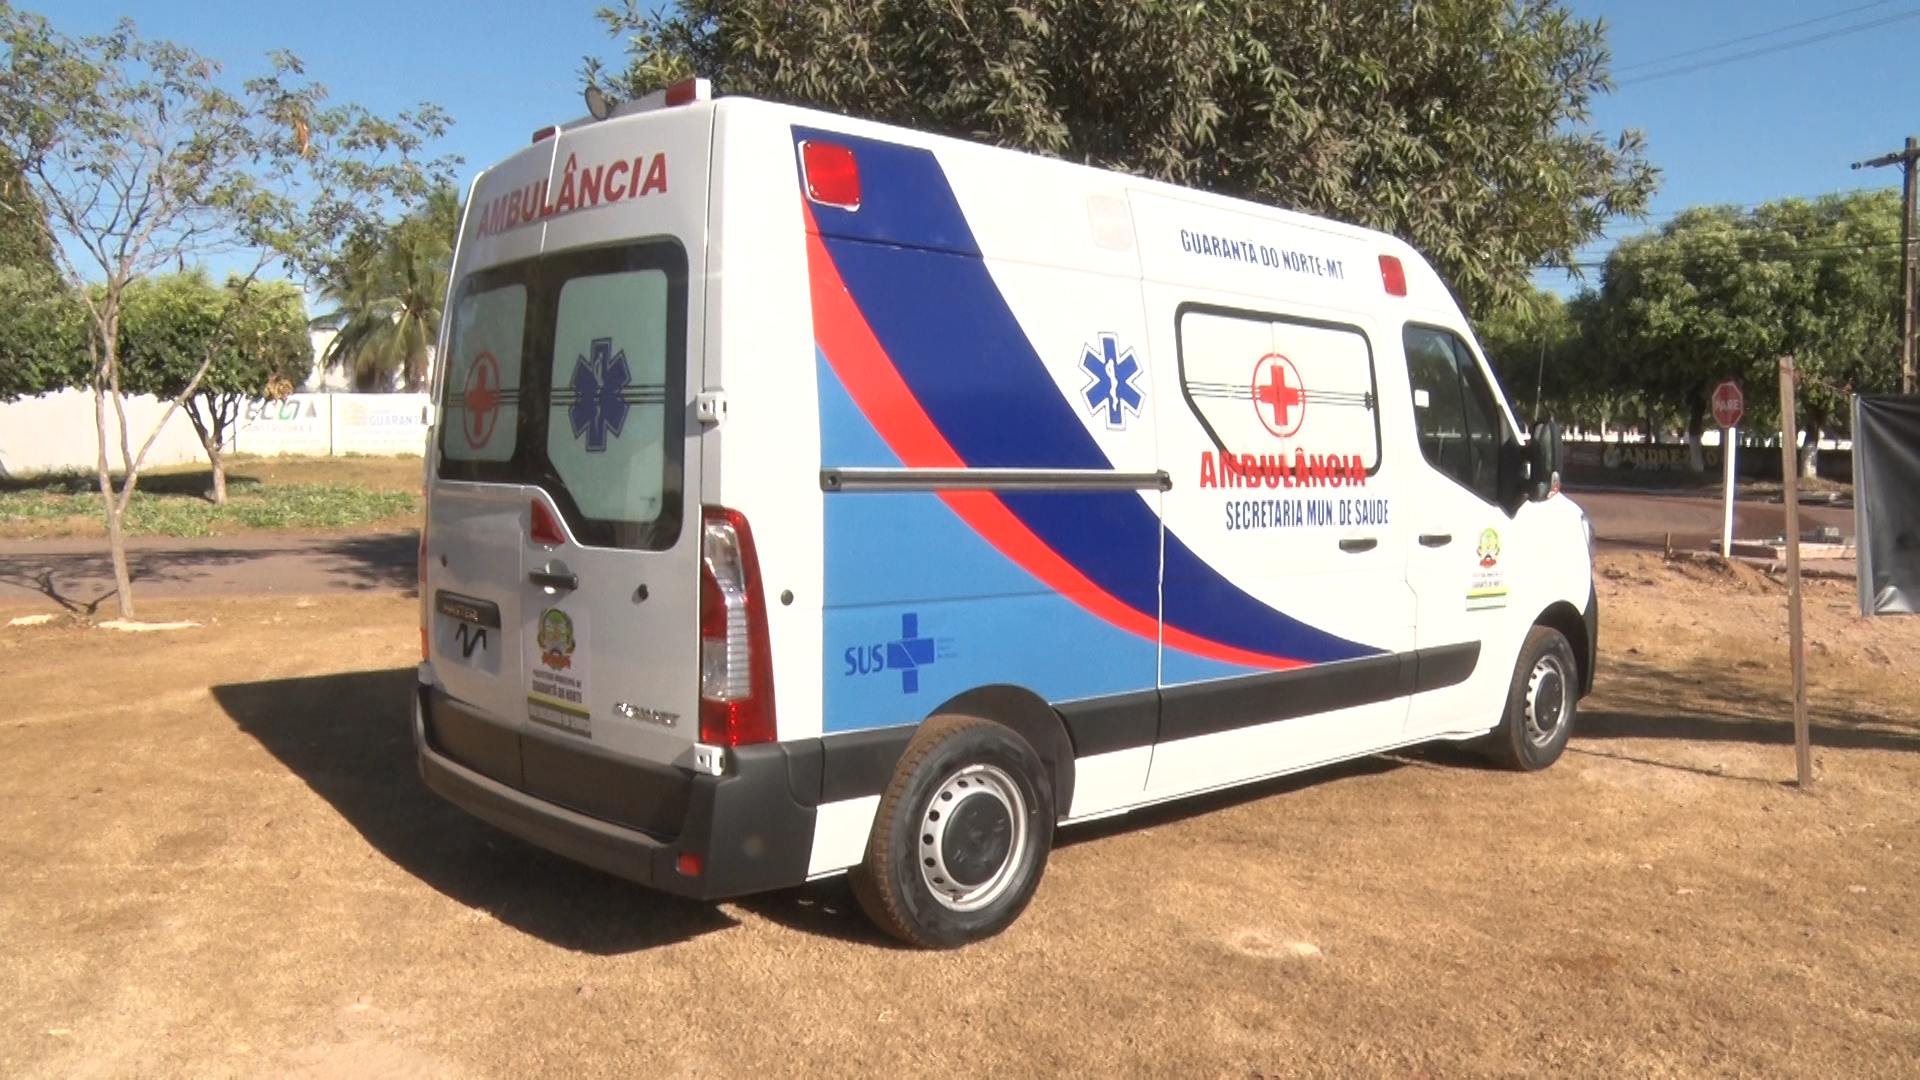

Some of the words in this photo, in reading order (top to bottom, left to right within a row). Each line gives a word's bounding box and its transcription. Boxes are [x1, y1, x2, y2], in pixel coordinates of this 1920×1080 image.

[475, 152, 668, 240] AMBULÂNCIA
[1259, 244, 1279, 269] DO
[1199, 446, 1367, 490] AMBULÂNCIA
[1225, 499, 1304, 531] SECRETARIA
[1306, 499, 1336, 527] MUN.
[1339, 498, 1353, 526] DE
[844, 643, 884, 676] SUS
